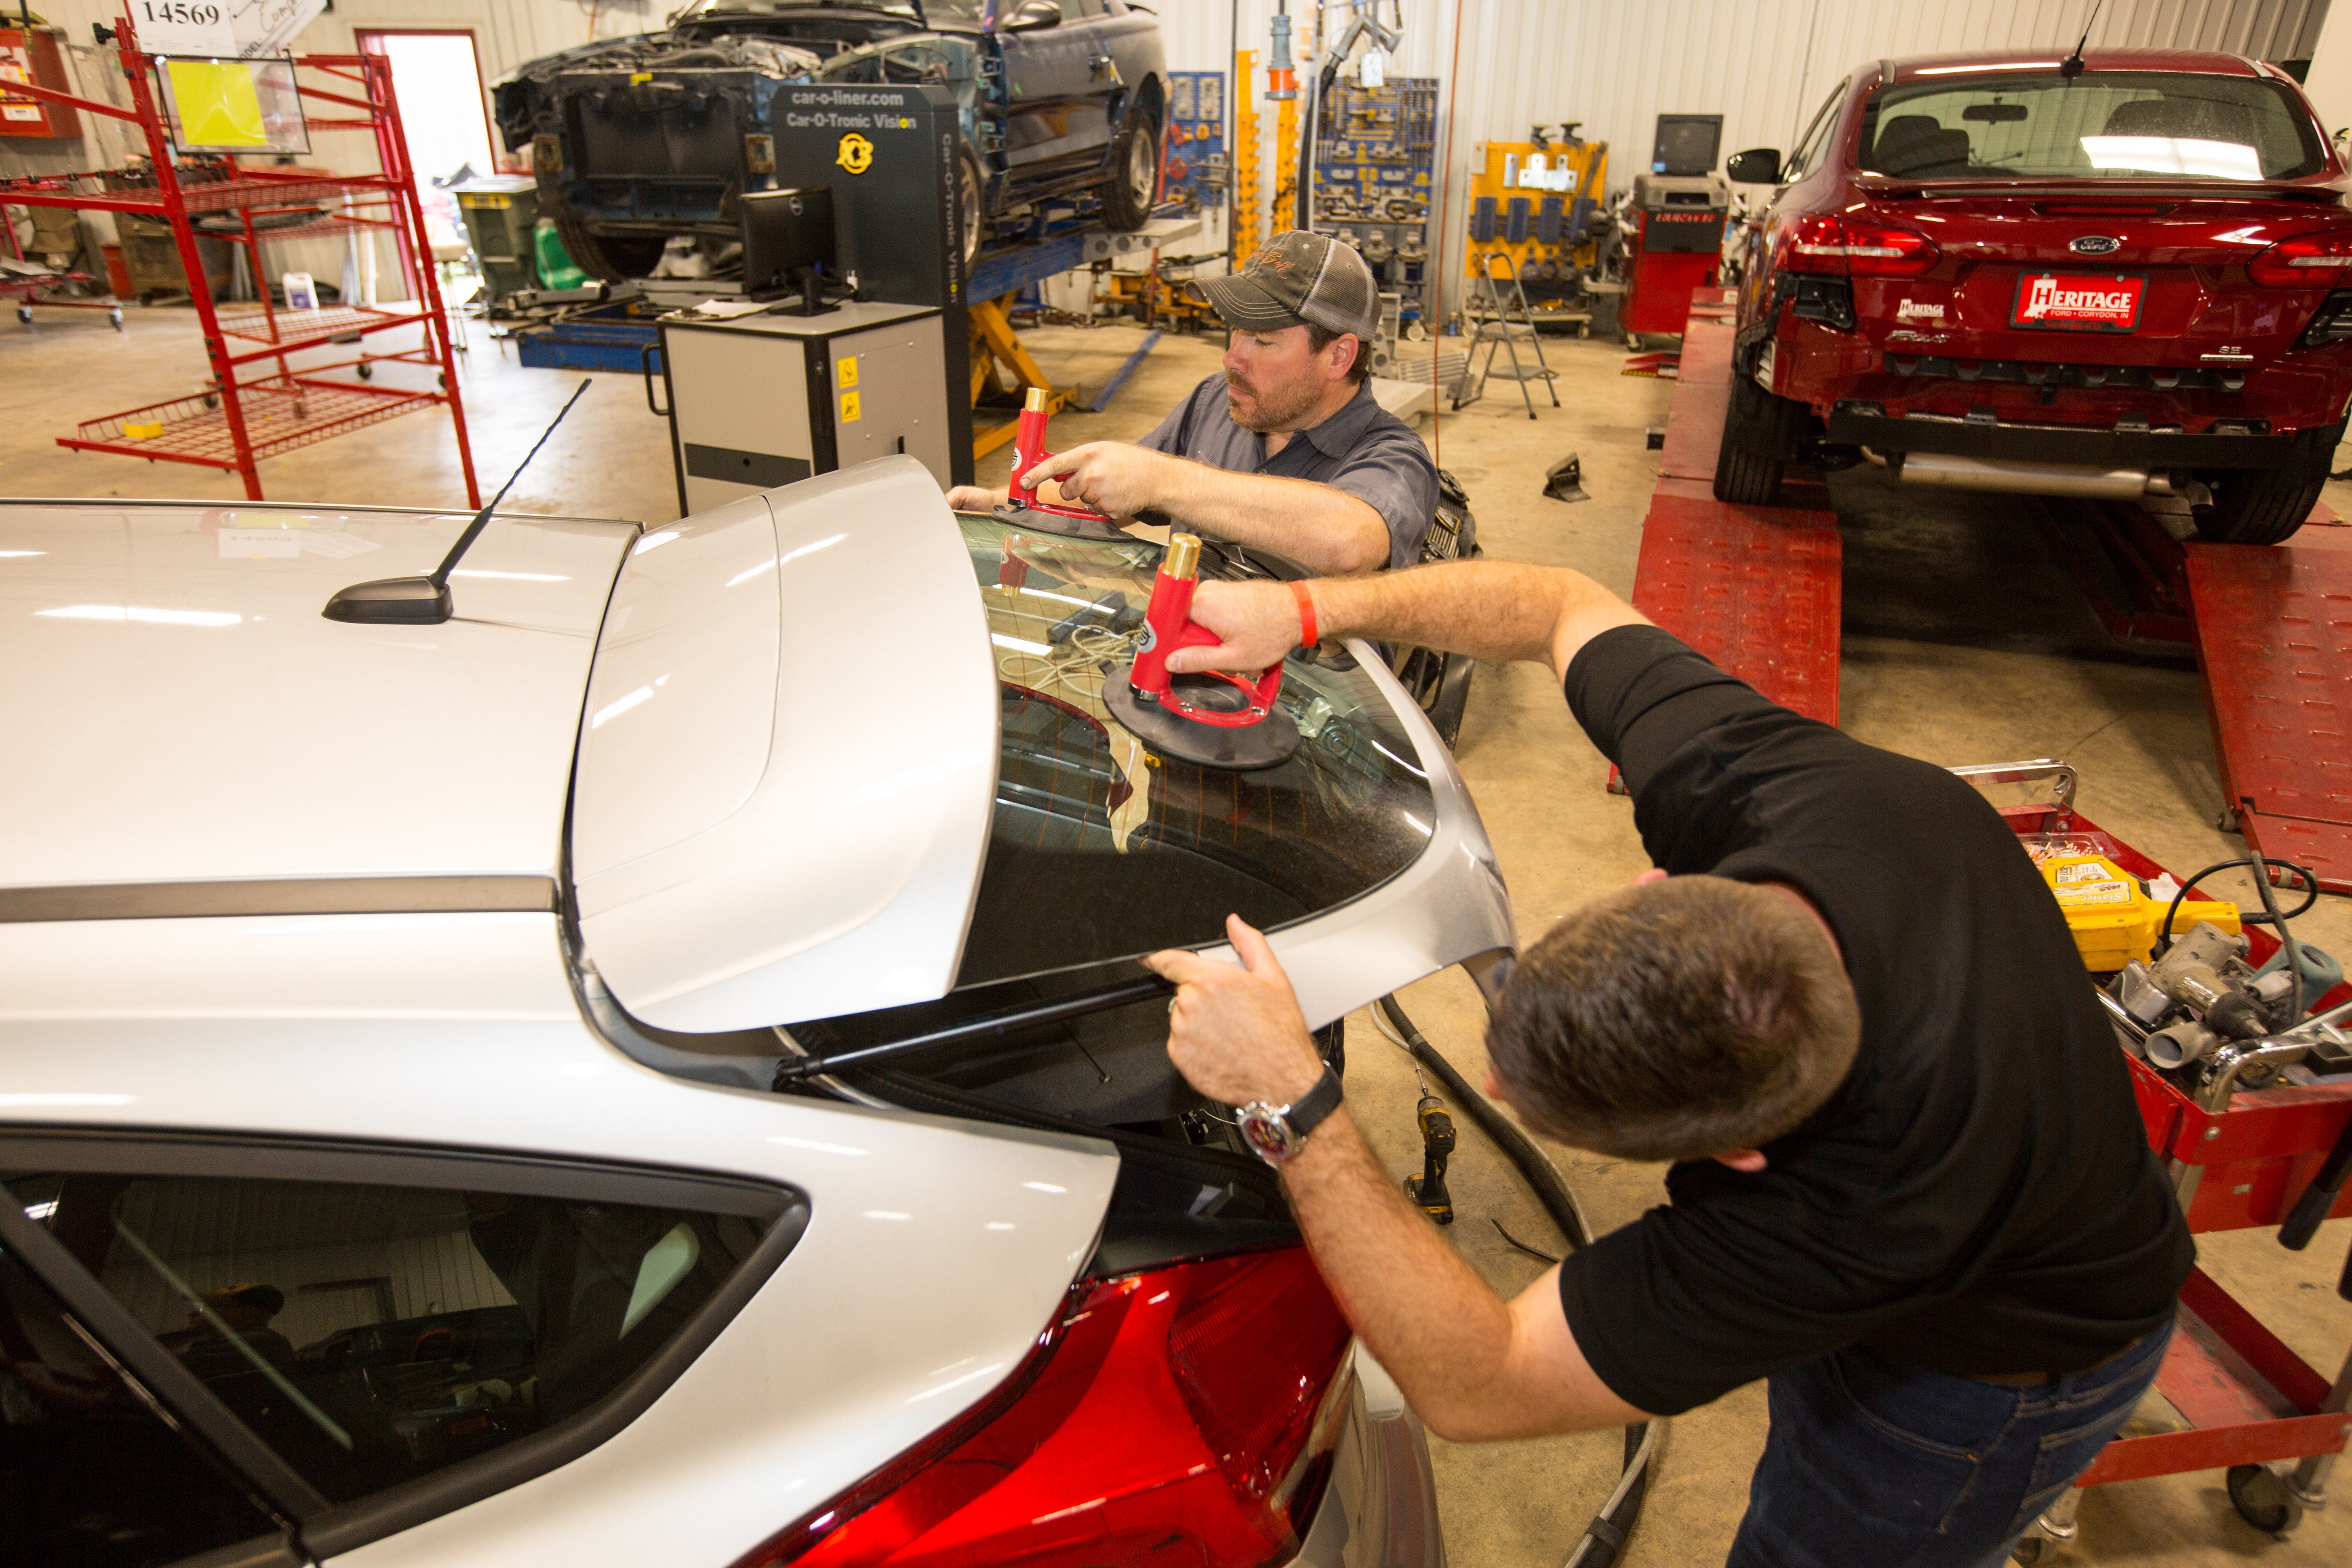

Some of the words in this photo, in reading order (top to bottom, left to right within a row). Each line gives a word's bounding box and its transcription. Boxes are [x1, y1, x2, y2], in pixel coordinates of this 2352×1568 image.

[144, 1, 219, 26] 14569
[791, 89, 904, 106] car-o-liner.com
[786, 112, 871, 128] Car-O-Tronic
[873, 114, 917, 129] Vision
[942, 133, 956, 246] Car-O-Tronic
[948, 250, 959, 305] Vision
[2031, 284, 2132, 309] HERITAGE
[2218, 346, 2242, 354] SE
